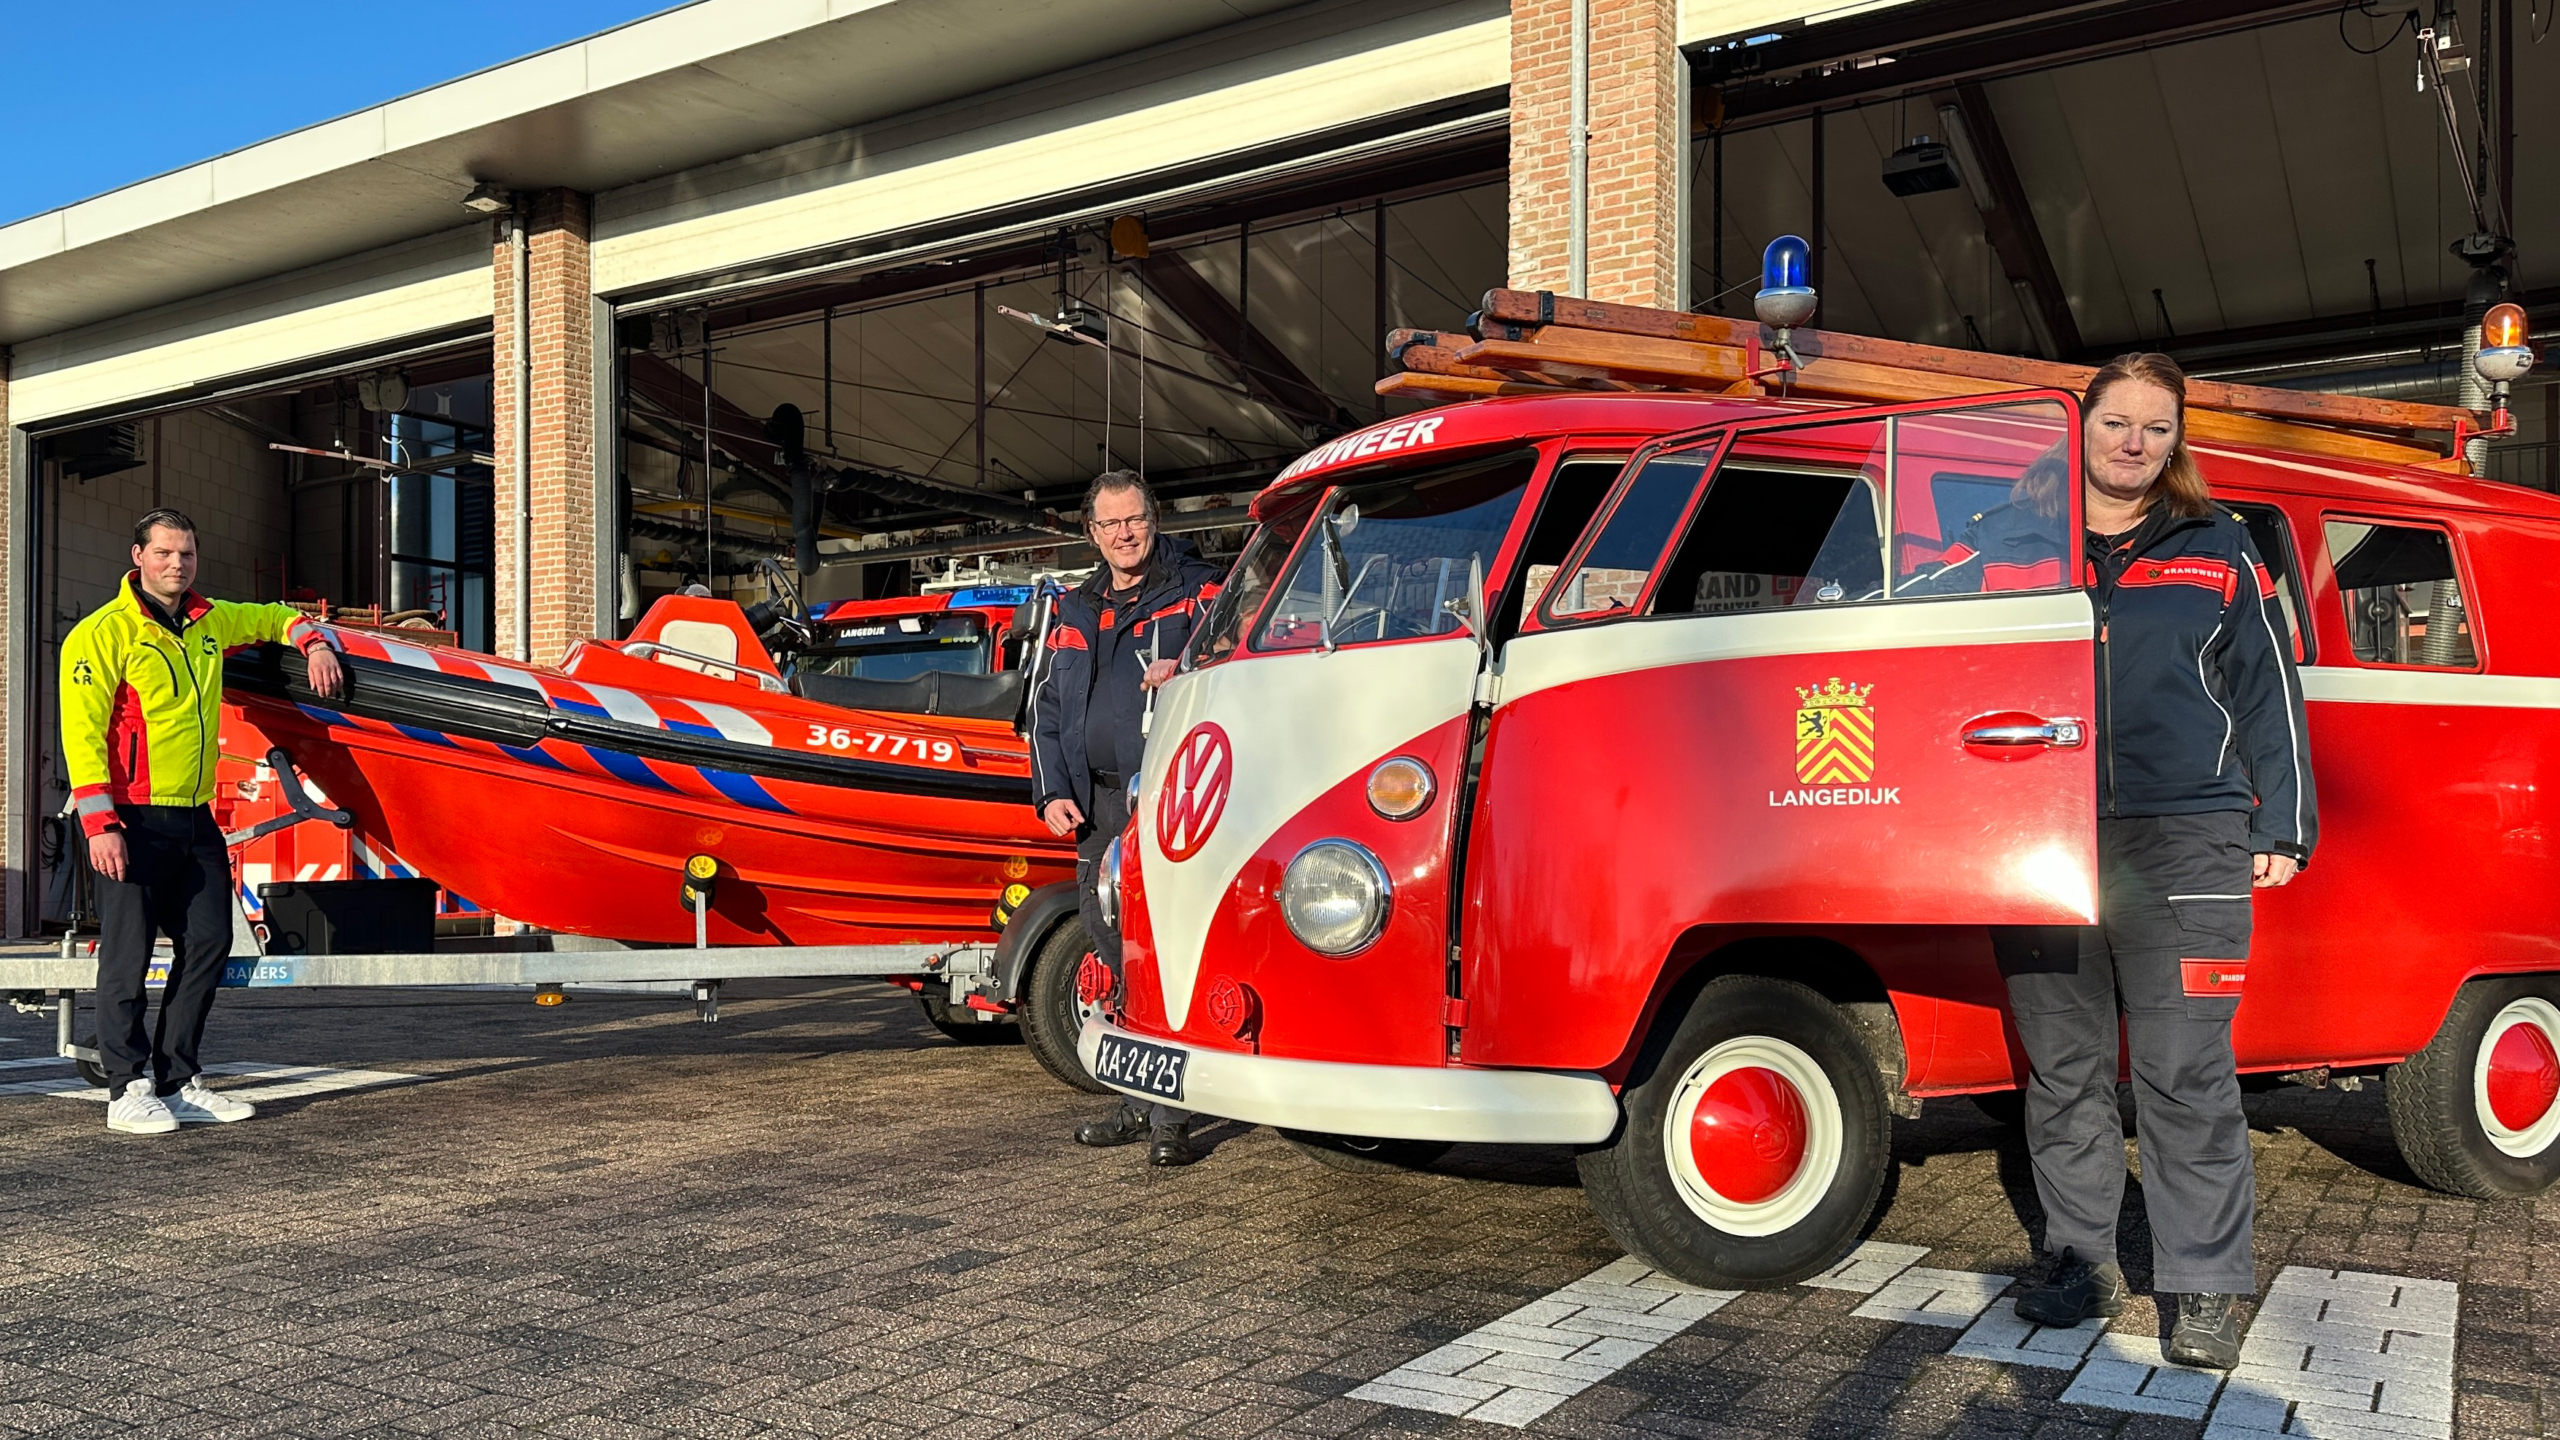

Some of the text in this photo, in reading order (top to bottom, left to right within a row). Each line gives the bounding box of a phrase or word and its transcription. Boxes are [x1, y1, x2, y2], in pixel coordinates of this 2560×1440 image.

[2163, 567, 2224, 579] BRANDWEER
[1696, 574, 1761, 600] RAND
[840, 626, 886, 639] LANGEDIJK
[806, 724, 953, 763] 36-7719
[1160, 726, 1229, 857] VW
[1769, 787, 1901, 807] LANGEDIJK
[225, 965, 288, 980] RAILERS
